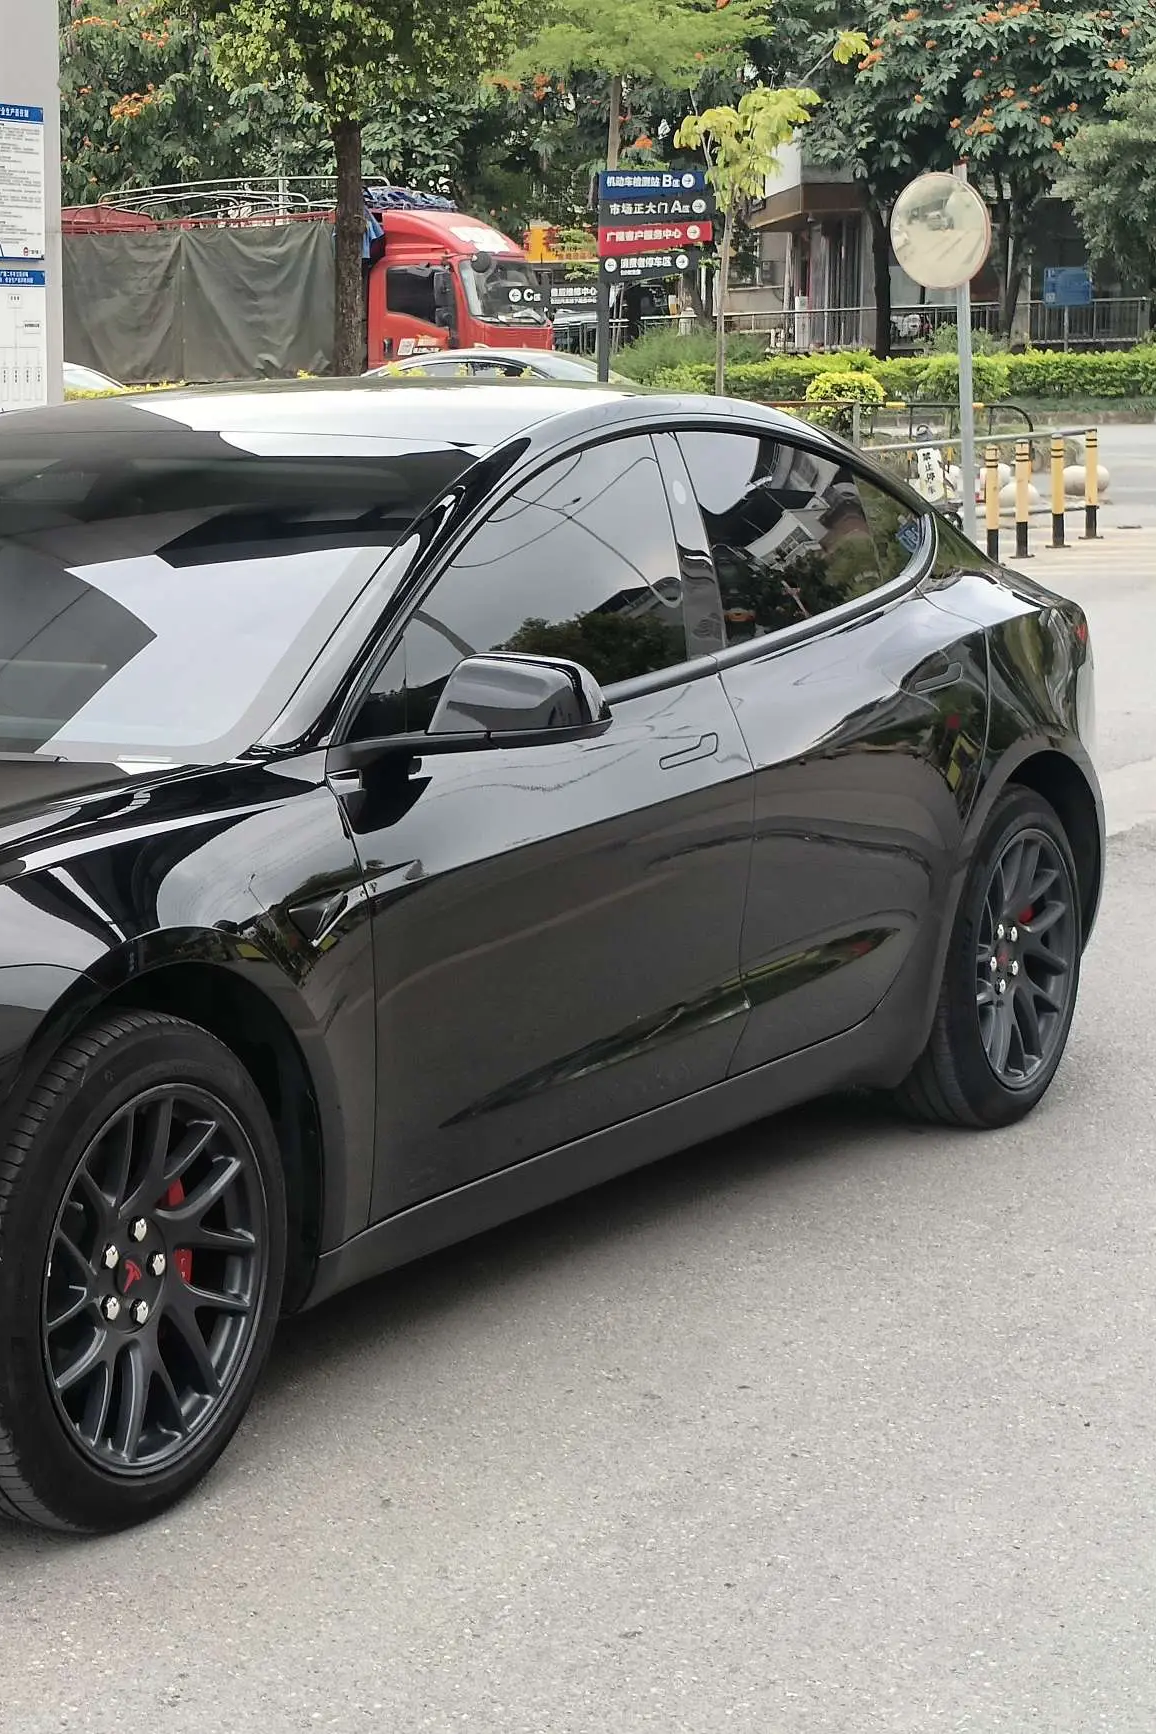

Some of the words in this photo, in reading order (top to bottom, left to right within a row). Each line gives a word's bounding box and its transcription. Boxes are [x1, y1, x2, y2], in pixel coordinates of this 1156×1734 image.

[609, 202, 668, 215] 市场正大门
